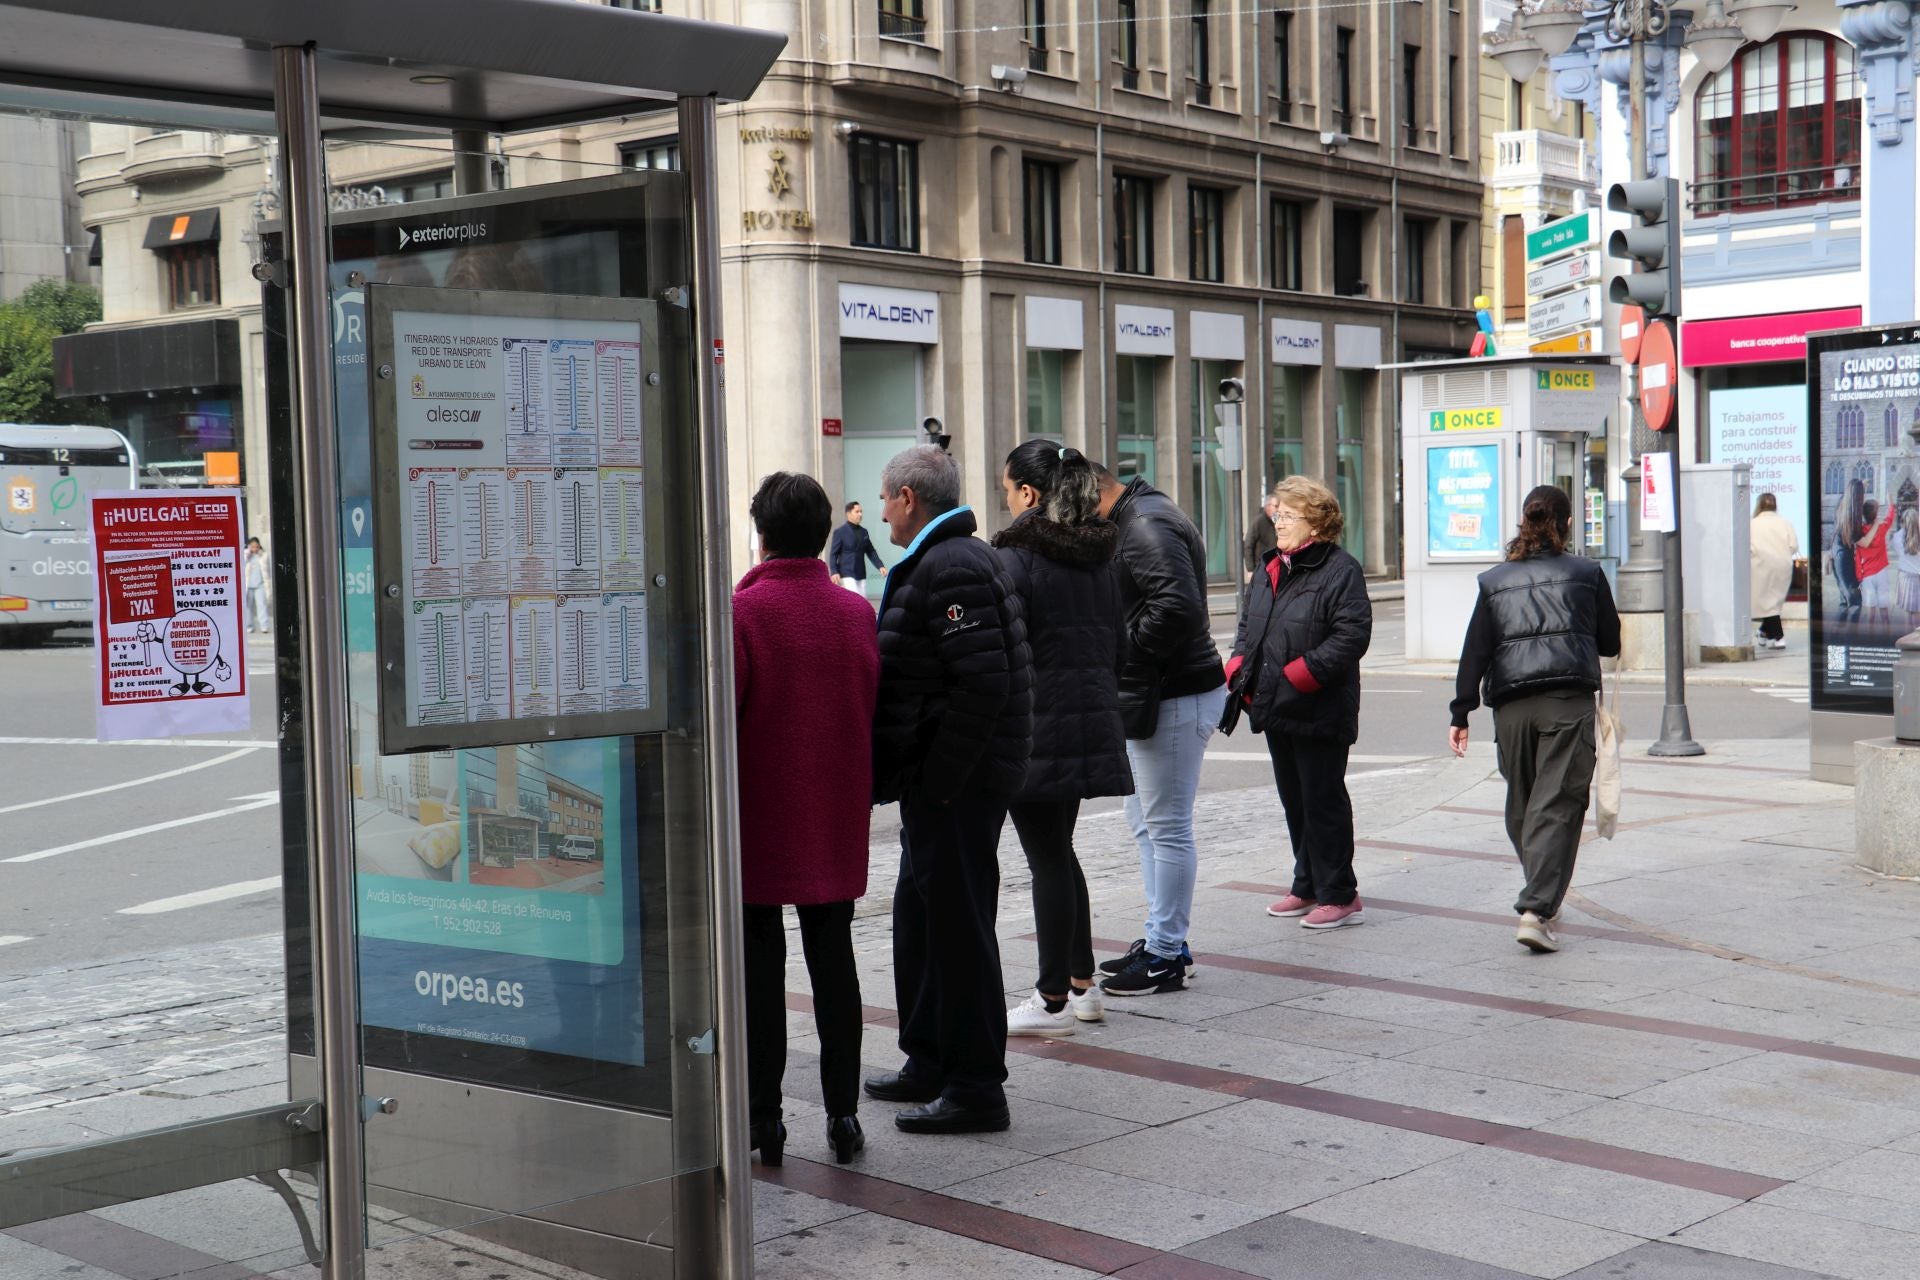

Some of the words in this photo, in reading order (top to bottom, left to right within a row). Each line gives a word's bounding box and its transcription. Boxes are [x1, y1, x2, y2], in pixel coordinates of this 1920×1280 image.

[743, 210, 812, 231] HOTEL
[841, 301, 934, 325] VITALDENT
[1119, 322, 1172, 338] VITALDENT
[404, 334, 451, 345] ITINERARIOS
[453, 335, 459, 344] Y
[459, 336, 498, 346] HORARIOS
[1274, 335, 1320, 349] VITALDENT
[1730, 339, 1755, 349] banca
[1757, 334, 1806, 346] cooperativa
[411, 346, 428, 356] RED
[429, 347, 440, 356] DE
[443, 347, 492, 357] TRANSPORTE
[336, 354, 366, 364] RESIDE
[418, 359, 451, 368] URBANO
[453, 360, 463, 368] DE
[466, 359, 486, 369] LEÓN
[1844, 357, 1894, 373] CUANDO
[1897, 355, 1920, 369] CRE
[1554, 373, 1590, 387] ONCE
[1834, 376, 1852, 391] LO
[1853, 374, 1878, 390] HAS
[1881, 372, 1919, 387] VISTO
[427, 405, 471, 422] alesa
[1451, 411, 1495, 427] ONCE
[1722, 411, 1785, 424] Trabajamos
[1721, 428, 1746, 439] para
[1748, 424, 1798, 437] construir
[1721, 439, 1793, 452] comunidades
[52, 448, 70, 462] 12
[1750, 469, 1782, 479] tarias
[1750, 483, 1796, 494] tenibles.
[103, 506, 190, 527] ¡¡HUELGA!!
[195, 504, 229, 514] CCOO
[32, 556, 91, 575] alesa
[110, 566, 137, 575] Jubilación
[138, 563, 166, 572] Anticipada
[130, 598, 154, 616] ¡YA!
[176, 599, 228, 608] NOVIEMBRE
[172, 620, 208, 628] APLICACIÓN
[170, 629, 211, 639] COEFICIENTES
[171, 639, 210, 648] REDUCTORES
[174, 649, 207, 659] CCOO
[138, 679, 171, 687] DICIEMBRE
[110, 689, 163, 699] INDEFINIDA
[366, 888, 390, 903] Avda
[392, 890, 406, 904] los
[407, 892, 457, 911] Peregrinos
[459, 897, 490, 914] 40-42,
[492, 904, 512, 916] Eras
[514, 905, 527, 917] de
[529, 905, 572, 922] Renueva
[443, 916, 461, 932] 952
[463, 918, 481, 933] 902
[484, 920, 501, 935] 528
[415, 970, 524, 1008] orpea.es
[427, 1024, 436, 1033] de
